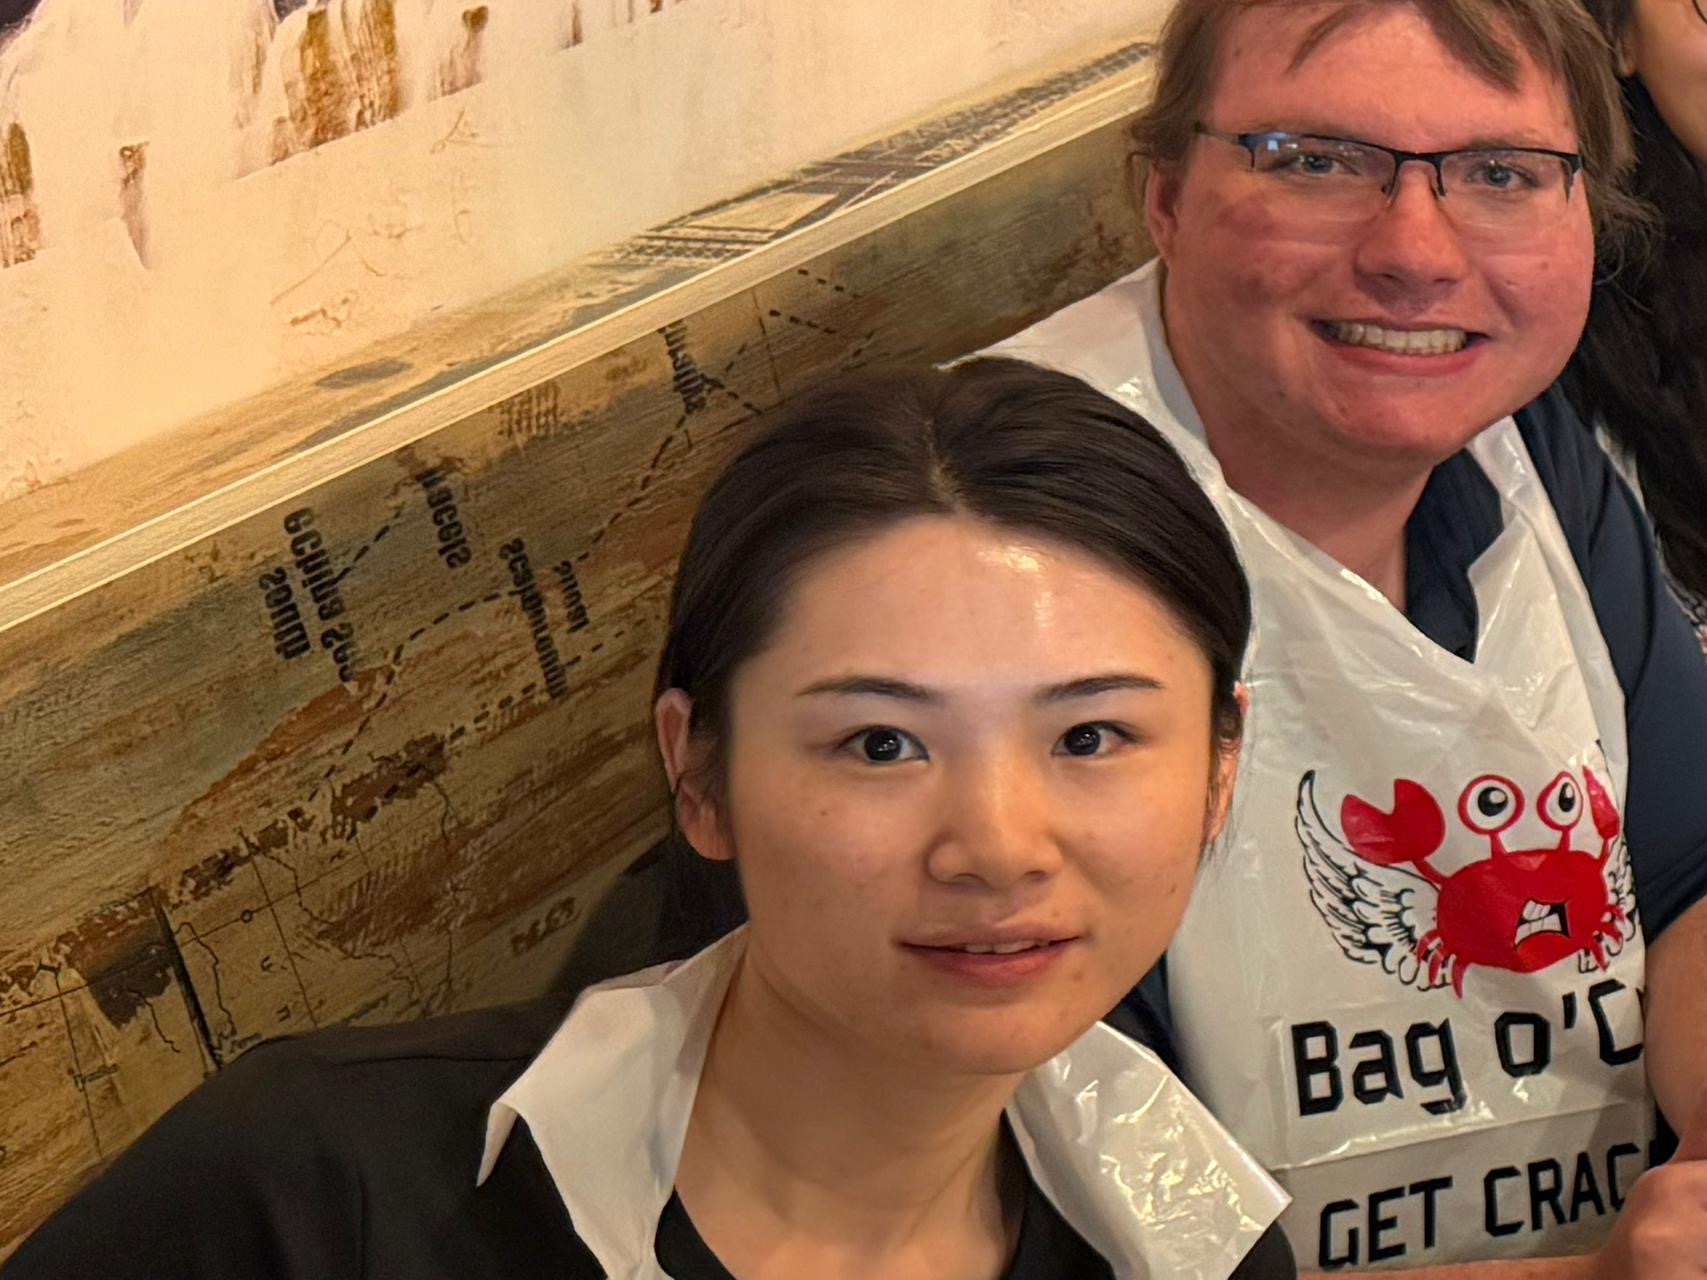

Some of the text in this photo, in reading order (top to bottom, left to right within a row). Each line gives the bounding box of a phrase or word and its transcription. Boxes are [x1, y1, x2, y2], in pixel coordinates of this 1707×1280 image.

[1290, 978, 1646, 1116] Bag o'C
[1317, 1140, 1662, 1270] GET CRAC
